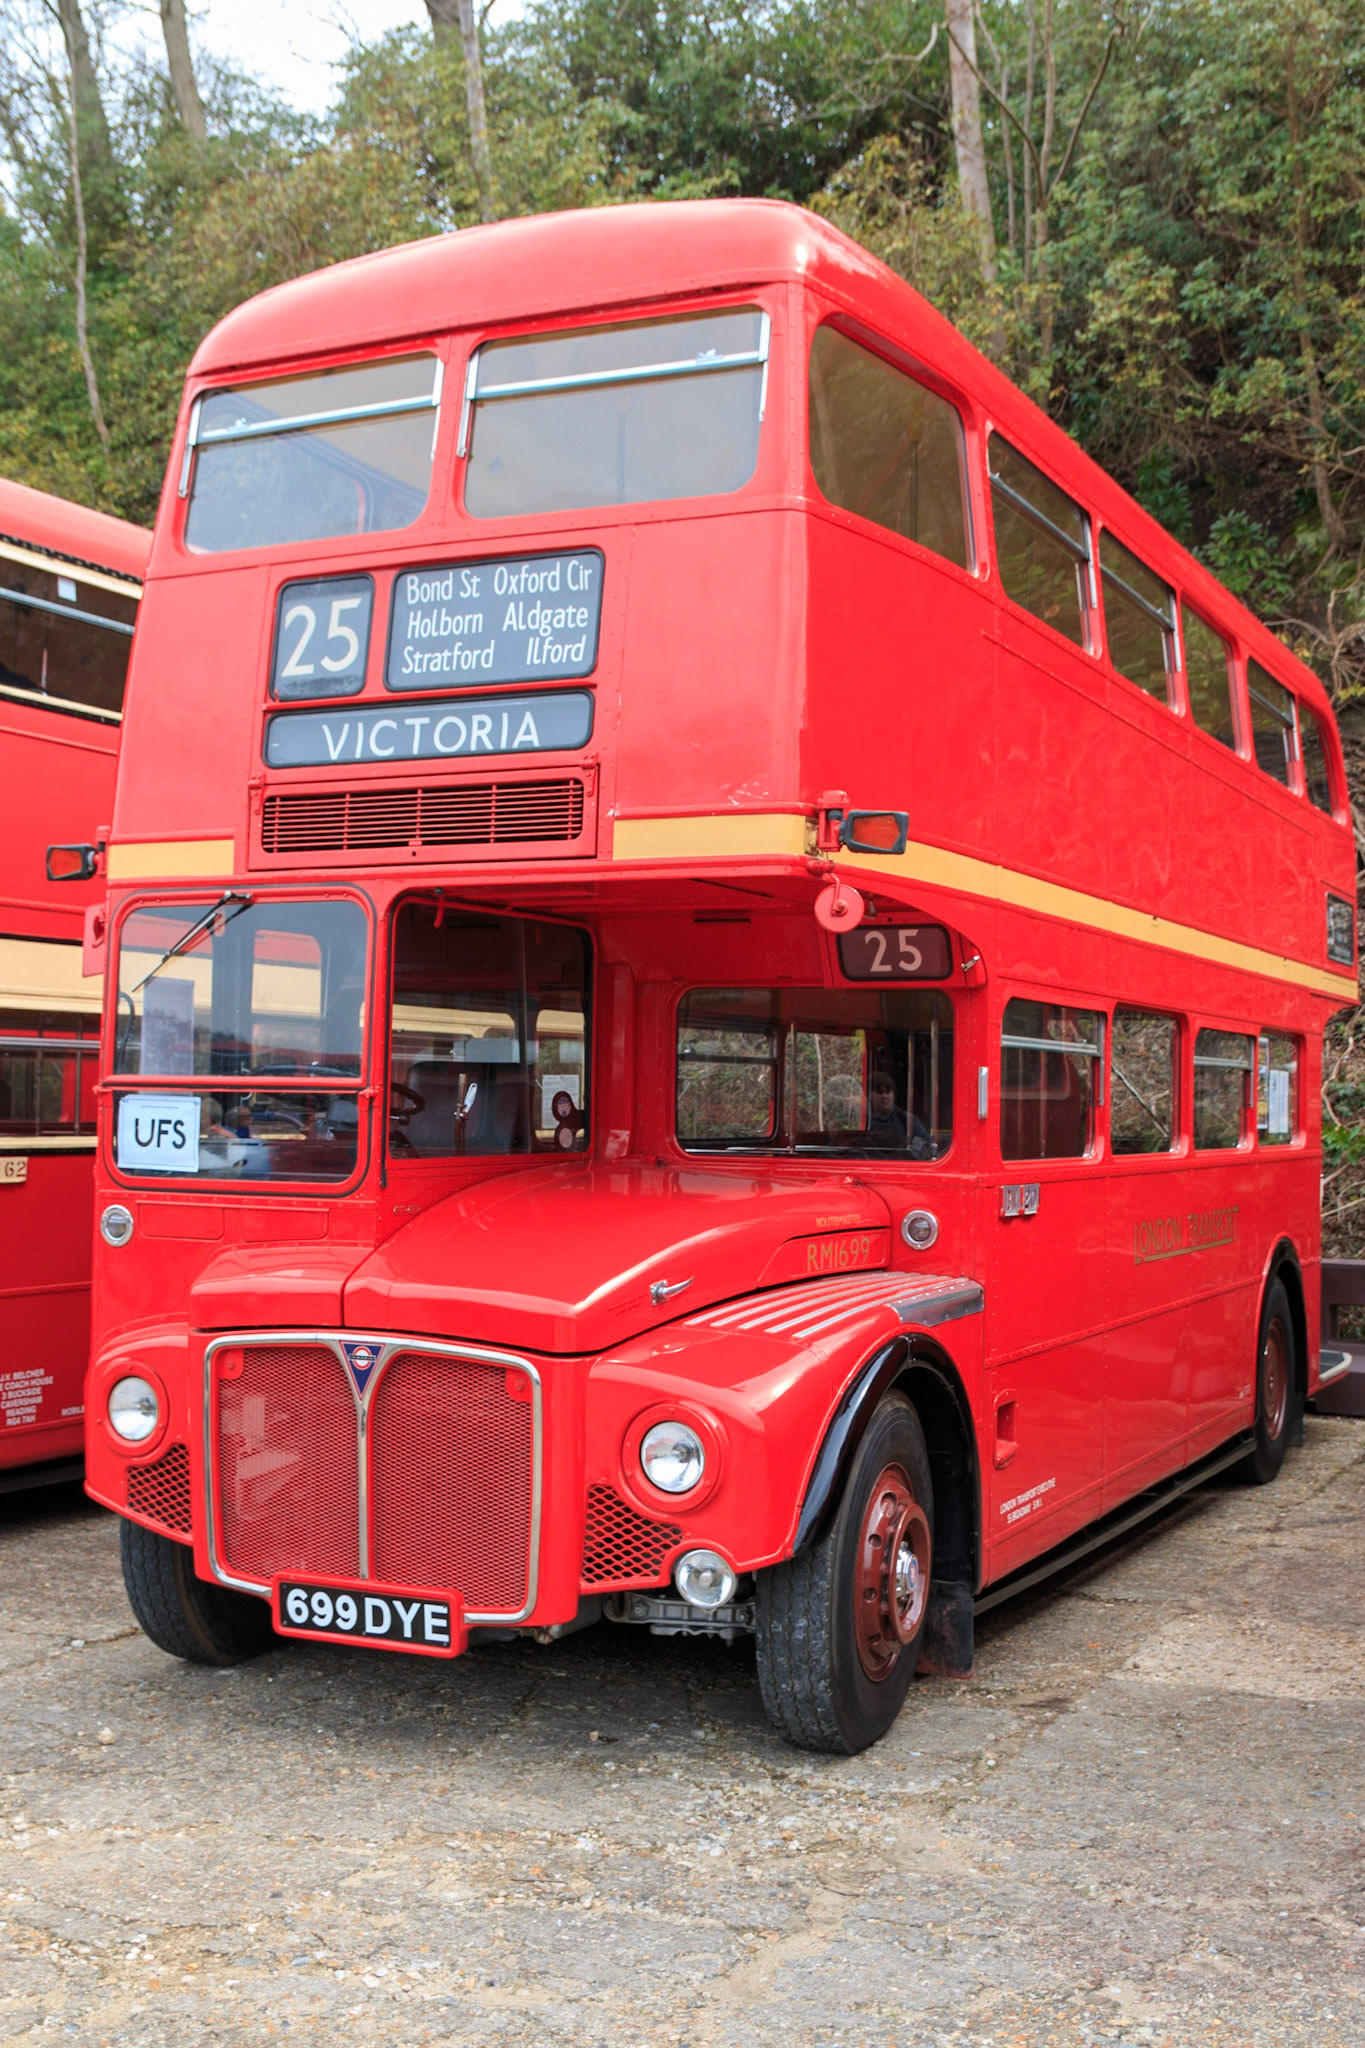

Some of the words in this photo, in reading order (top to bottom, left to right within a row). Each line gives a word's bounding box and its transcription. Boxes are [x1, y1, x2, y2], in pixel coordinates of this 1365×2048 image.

[406, 571, 453, 605] Bond
[459, 569, 481, 599] St
[494, 561, 561, 596] Oxford
[566, 559, 593, 592] Cir
[281, 597, 362, 678] 25
[407, 609, 484, 640] Holborn
[502, 600, 589, 637] Aldgate
[401, 639, 495, 675] Stratford
[526, 635, 587, 666] Ilford
[322, 711, 540, 761] VICTORIA
[864, 928, 923, 973] 25
[135, 1117, 187, 1150] UFS
[815, 1213, 861, 1228] ROUTEMASTER
[1134, 1217, 1182, 1266] LONDON
[1187, 1206, 1240, 1246] TRANSPORT
[807, 1236, 870, 1272] RM1699
[1, 1395, 43, 1409] CAVERSHAM
[4, 1380, 29, 1390] COACH
[31, 1376, 54, 1386] HOUSE
[6, 1405, 37, 1417] READING
[1000, 1498, 1017, 1515] LONDON
[1017, 1485, 1037, 1505] TRANSPORT
[285, 1588, 358, 1631] 699
[364, 1596, 450, 1642] DYE
